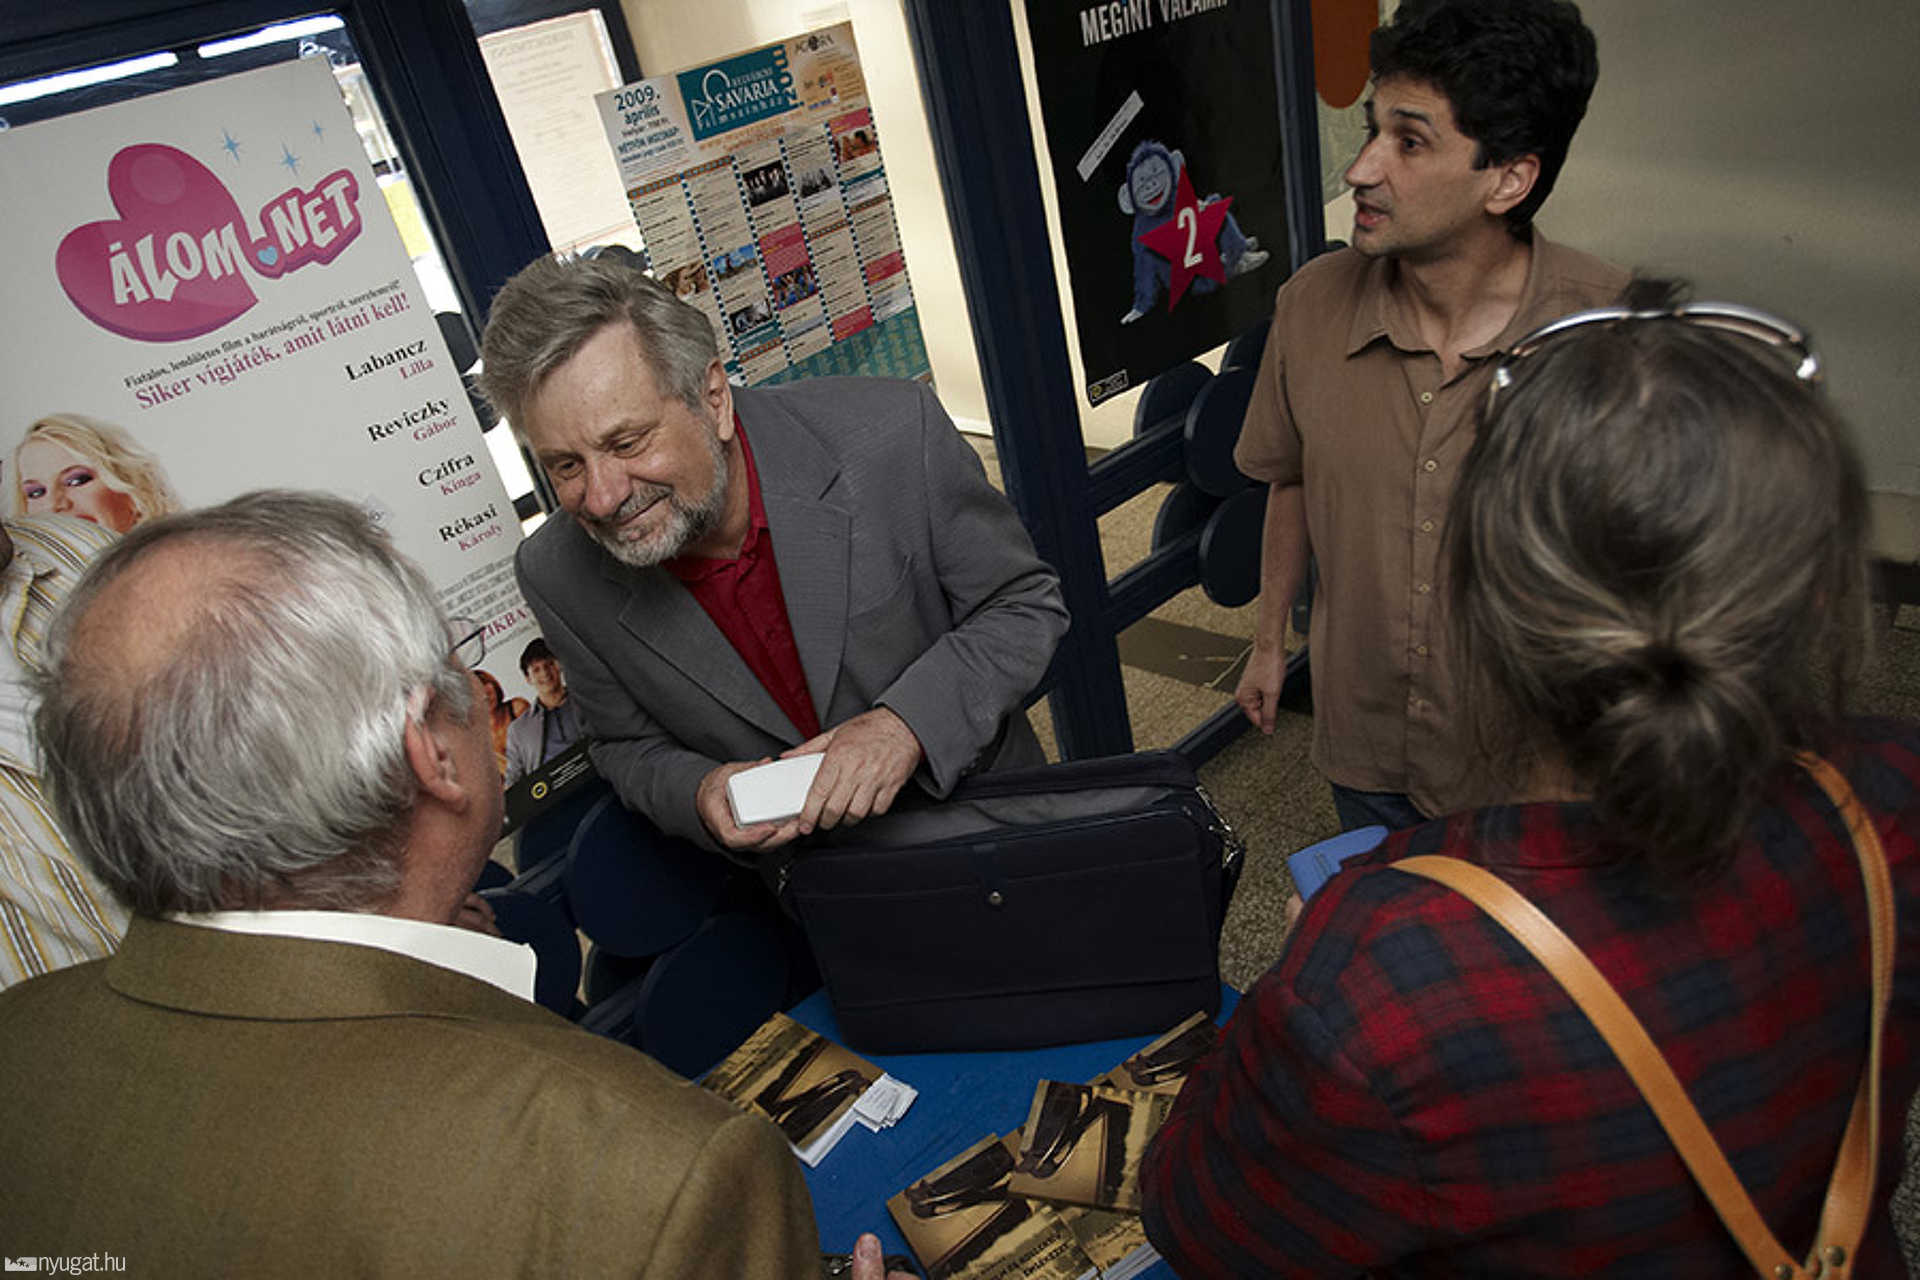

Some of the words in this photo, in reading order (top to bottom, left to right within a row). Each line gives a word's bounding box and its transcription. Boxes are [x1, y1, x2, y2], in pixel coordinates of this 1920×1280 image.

[614, 85, 660, 111] 2009.
[713, 79, 779, 112] SAVARIA
[1177, 207, 1202, 269] 2
[135, 377, 191, 409] Siker
[283, 325, 327, 355] amit
[326, 307, 371, 338] látni
[371, 291, 411, 321] kell!
[345, 339, 428, 381] Labancz
[399, 358, 435, 380] Lilla
[367, 398, 450, 442] Reviczky
[412, 415, 458, 442] Gábor
[418, 454, 475, 487] Czifra
[441, 471, 482, 496] Kinga
[438, 502, 498, 543] Rékasi
